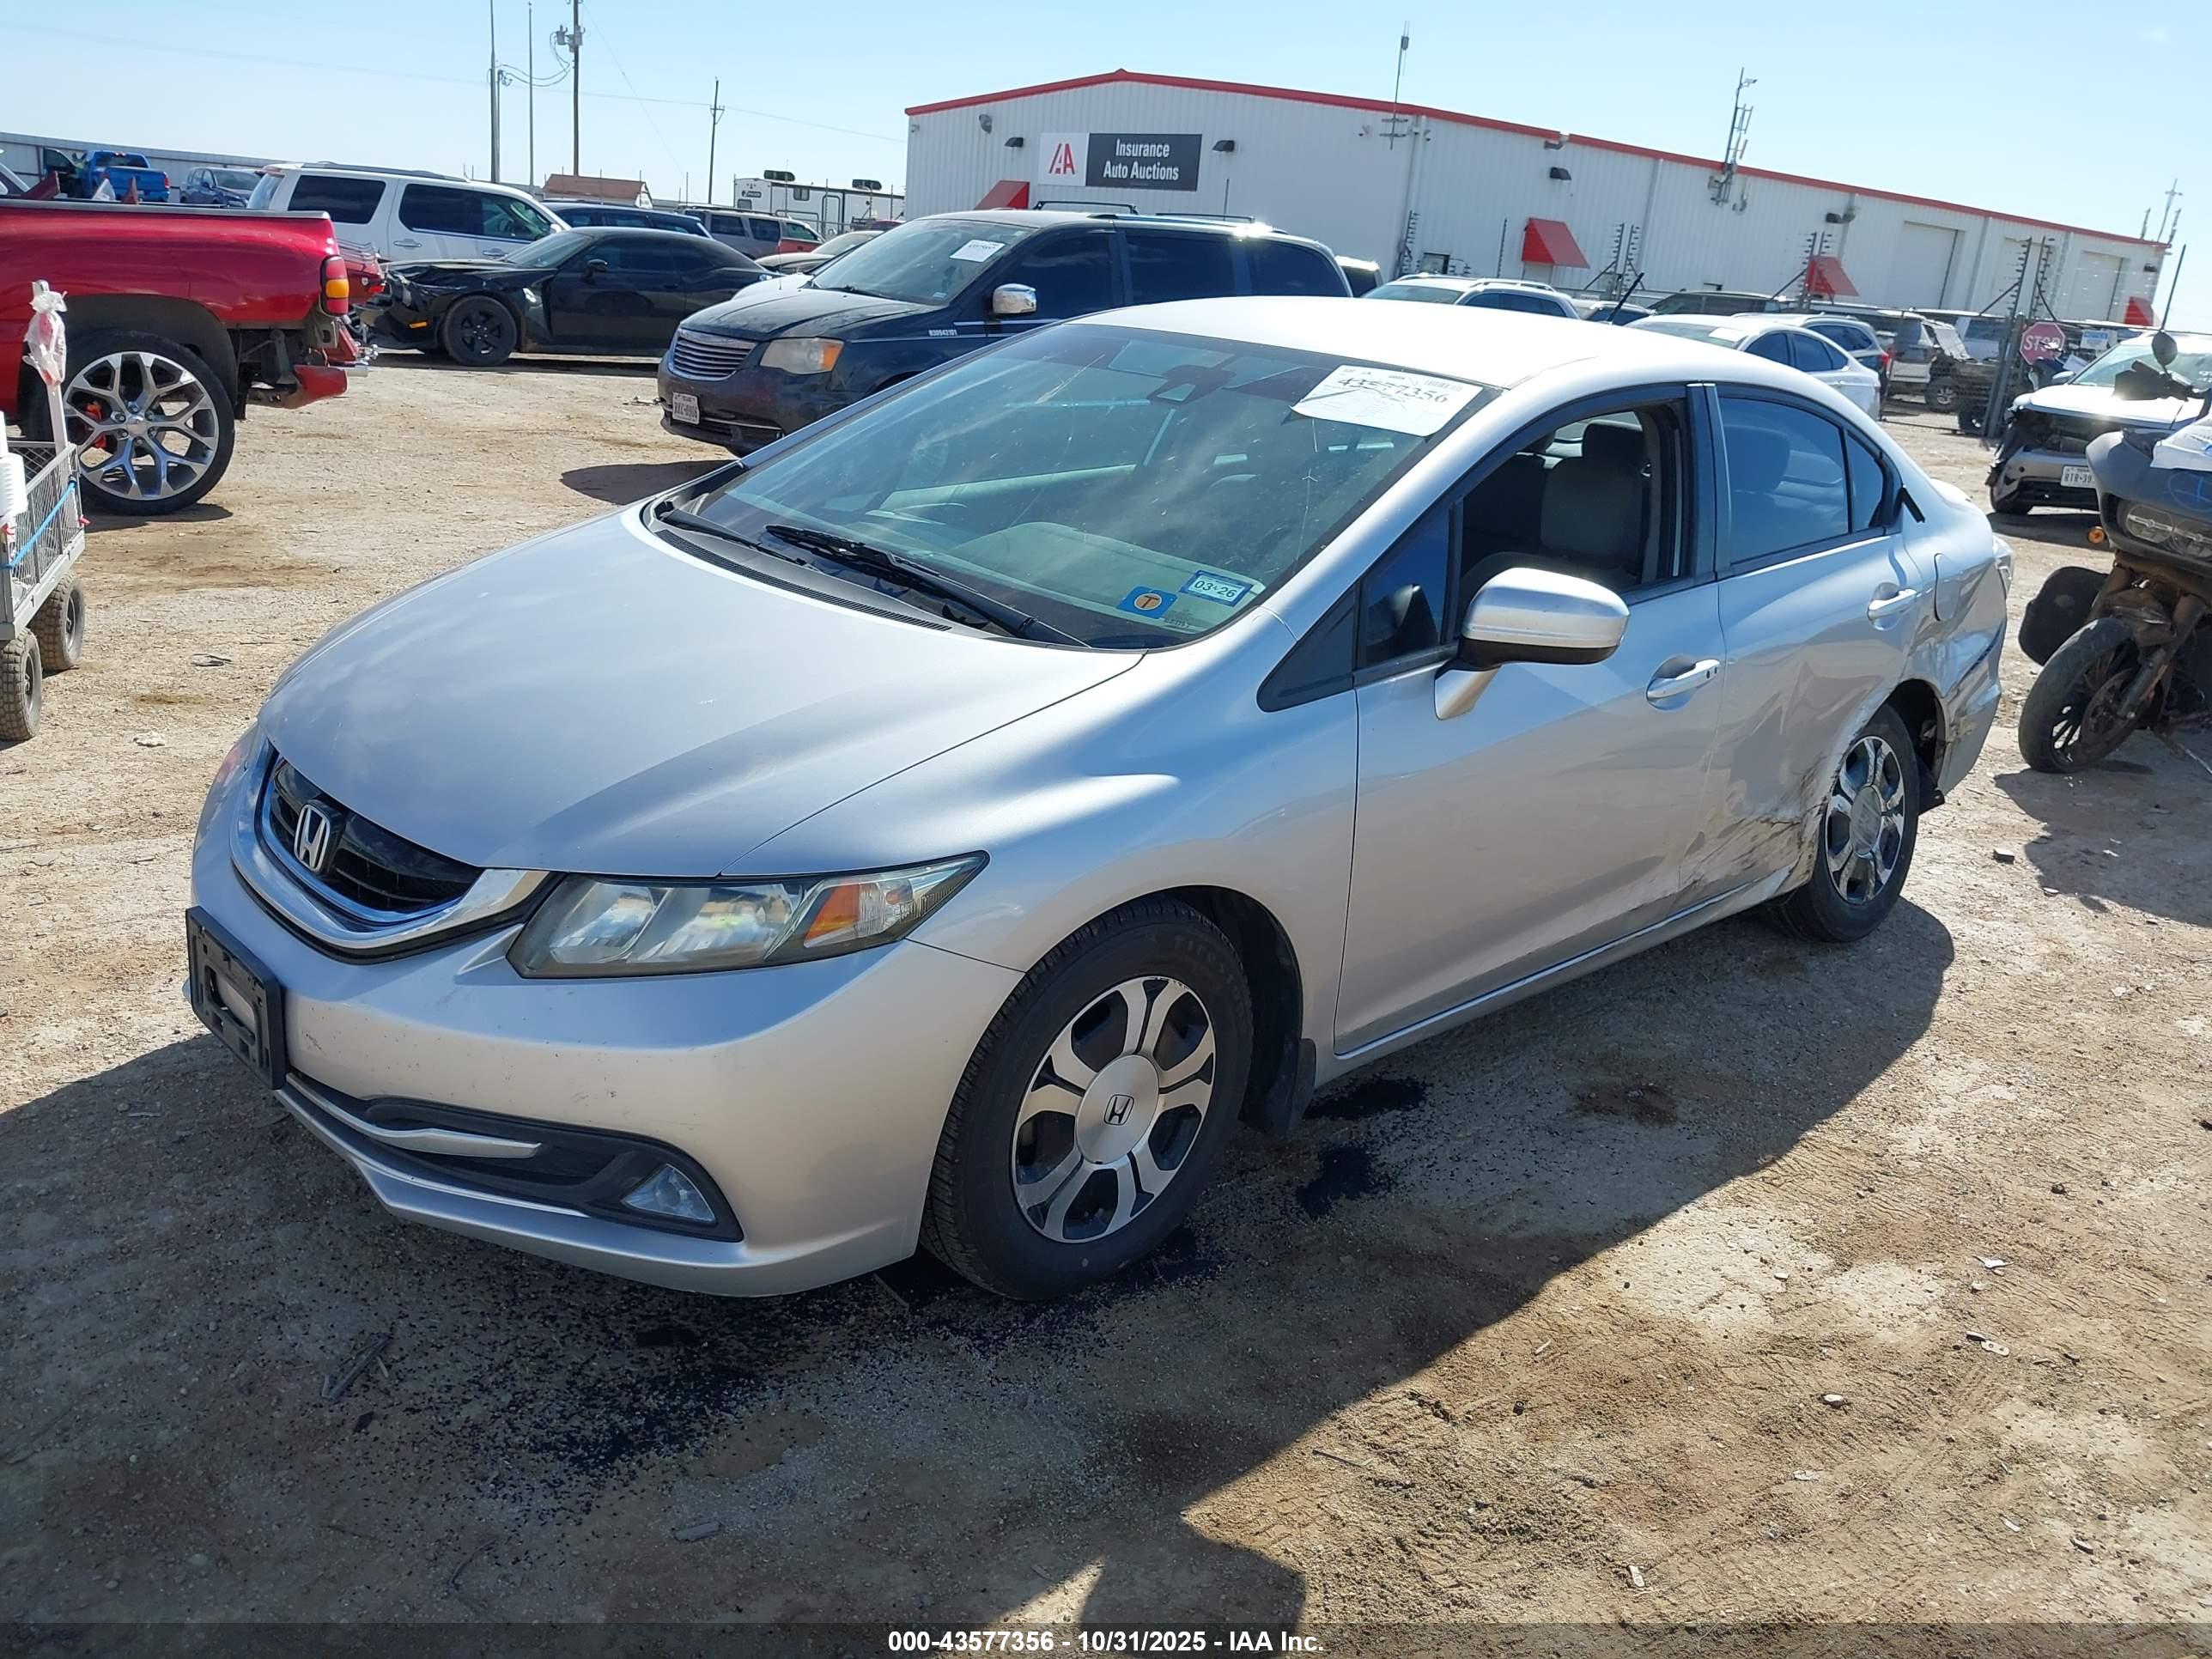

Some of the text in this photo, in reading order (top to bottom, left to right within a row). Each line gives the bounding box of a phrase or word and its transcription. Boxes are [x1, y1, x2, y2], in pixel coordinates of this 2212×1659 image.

[1116, 139, 1170, 157] Insurance
[1103, 161, 1180, 180] Auto Auctions
